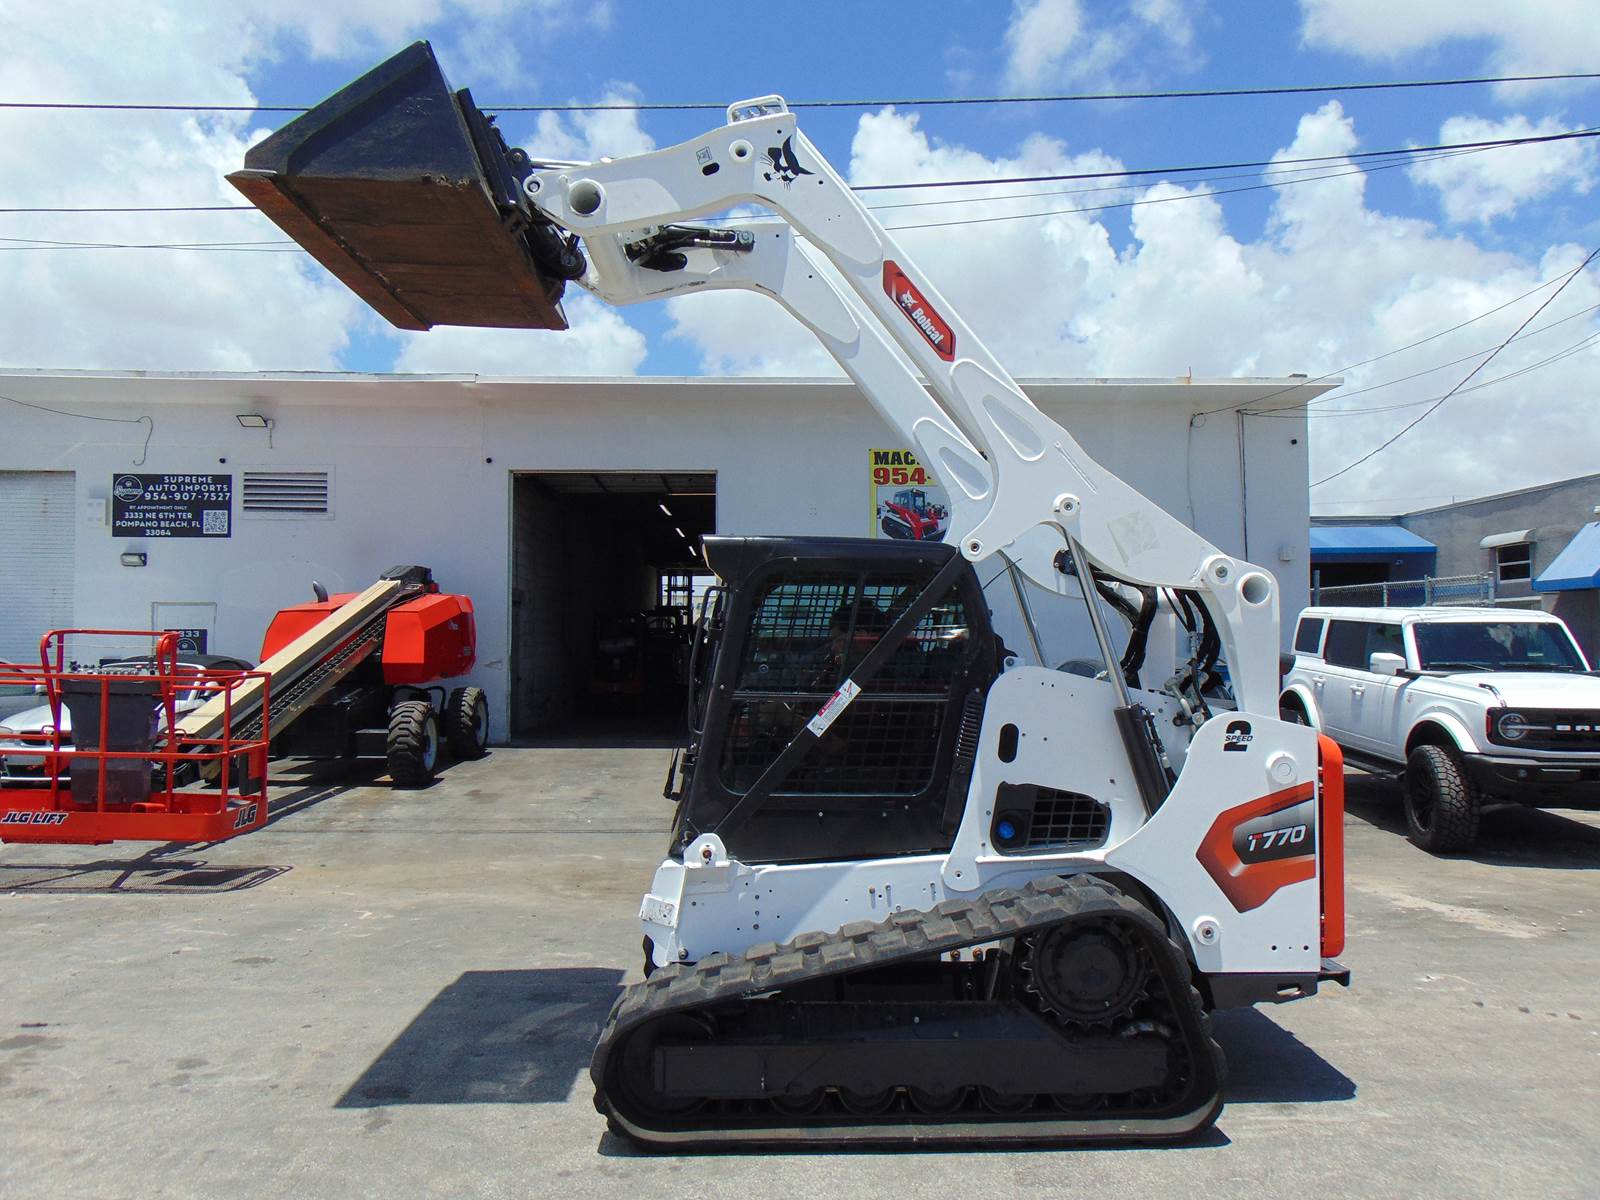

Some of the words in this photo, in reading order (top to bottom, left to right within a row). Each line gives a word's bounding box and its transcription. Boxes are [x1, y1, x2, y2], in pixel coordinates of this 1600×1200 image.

[911, 307, 944, 344] Bobcat
[873, 451, 920, 465] MAC
[164, 475, 213, 483] SUPREME
[147, 484, 178, 492] AUTO
[180, 484, 229, 492] IMPORTS
[144, 492, 231, 500] 954-907-7527
[124, 511, 144, 519] 3333
[115, 520, 159, 528] POMPANO
[160, 520, 190, 528] BEACH,
[191, 520, 201, 528] FL
[179, 630, 200, 638] 333
[1223, 720, 1252, 752] 2
[1225, 734, 1253, 742] SPEED
[0, 811, 32, 825] JLG
[30, 812, 69, 825] LIFT
[233, 803, 258, 829] JLG
[1248, 824, 1307, 852] T770
